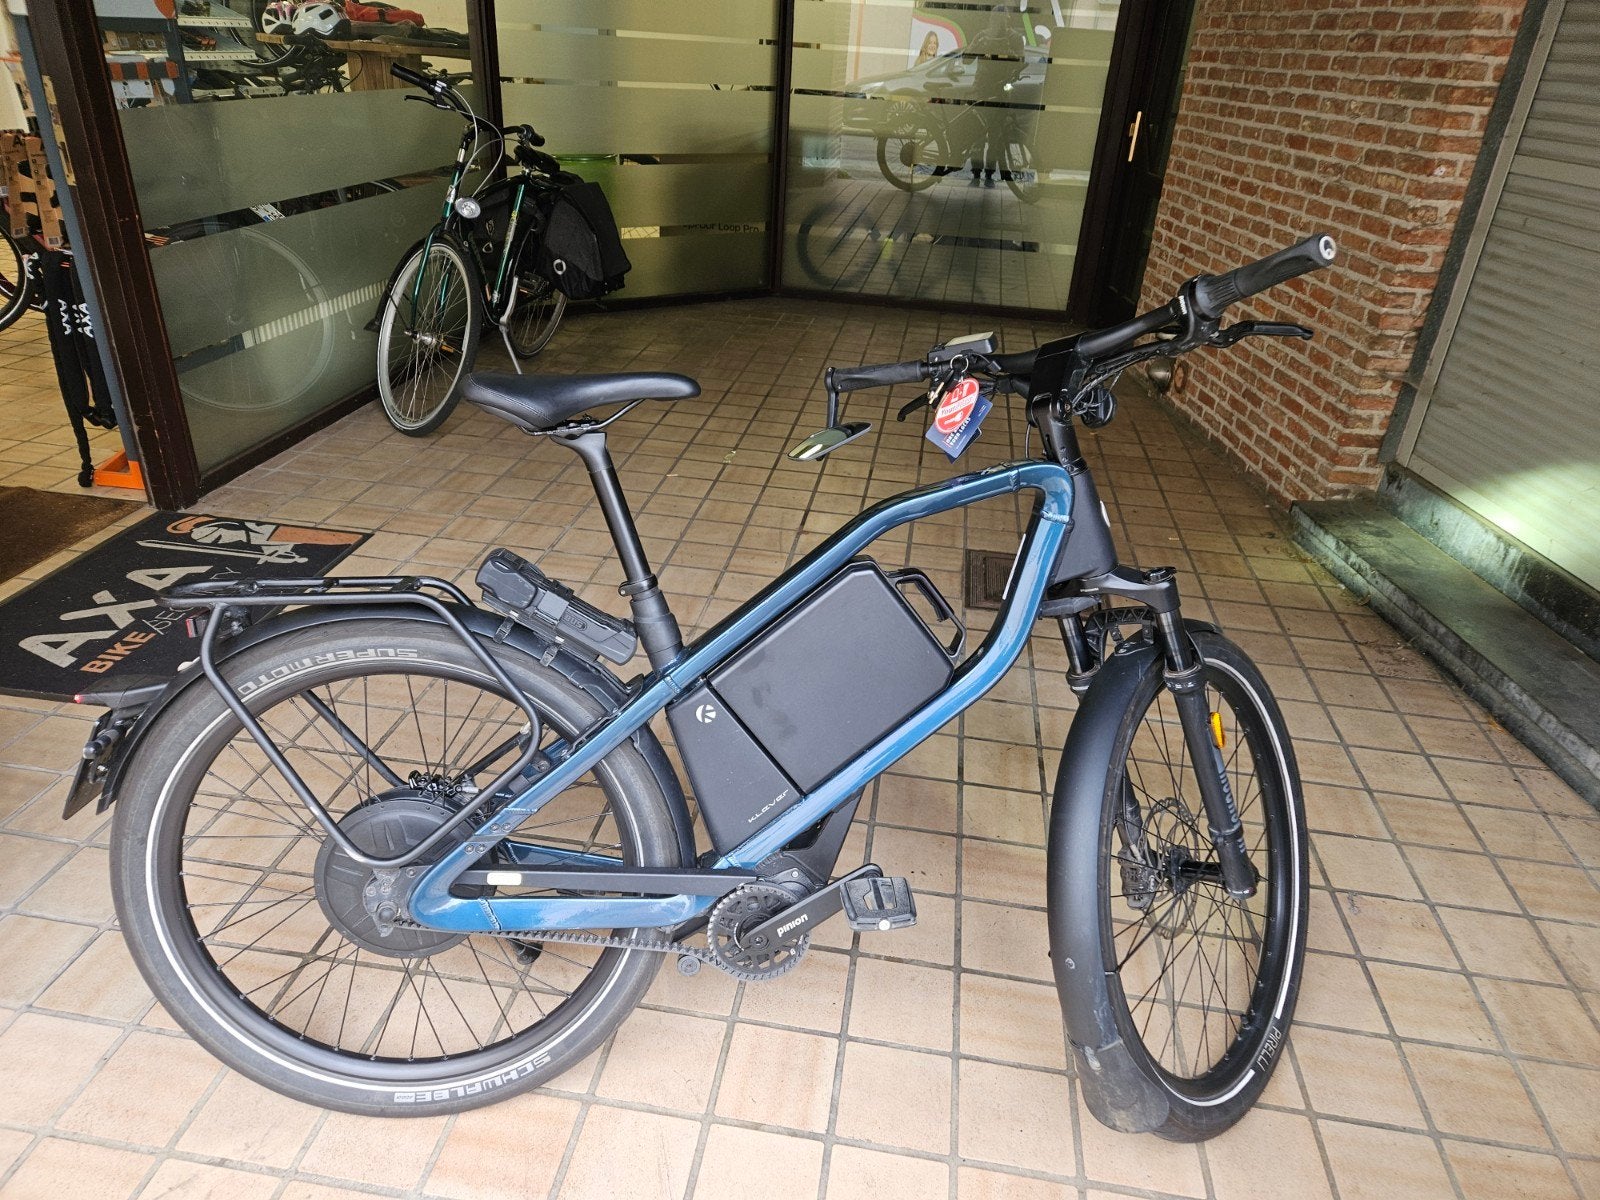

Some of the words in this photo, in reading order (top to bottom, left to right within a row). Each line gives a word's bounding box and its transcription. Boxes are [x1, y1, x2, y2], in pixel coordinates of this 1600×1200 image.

[718, 223, 741, 232] Loop
[18, 565, 214, 668] AXA
[80, 631, 156, 674] BIKE
[237, 648, 418, 696] SUPERMOTO
[776, 913, 809, 938] pinion
[1255, 1025, 1282, 1072] PIRELLI
[415, 1051, 552, 1103] SCHWALBE
